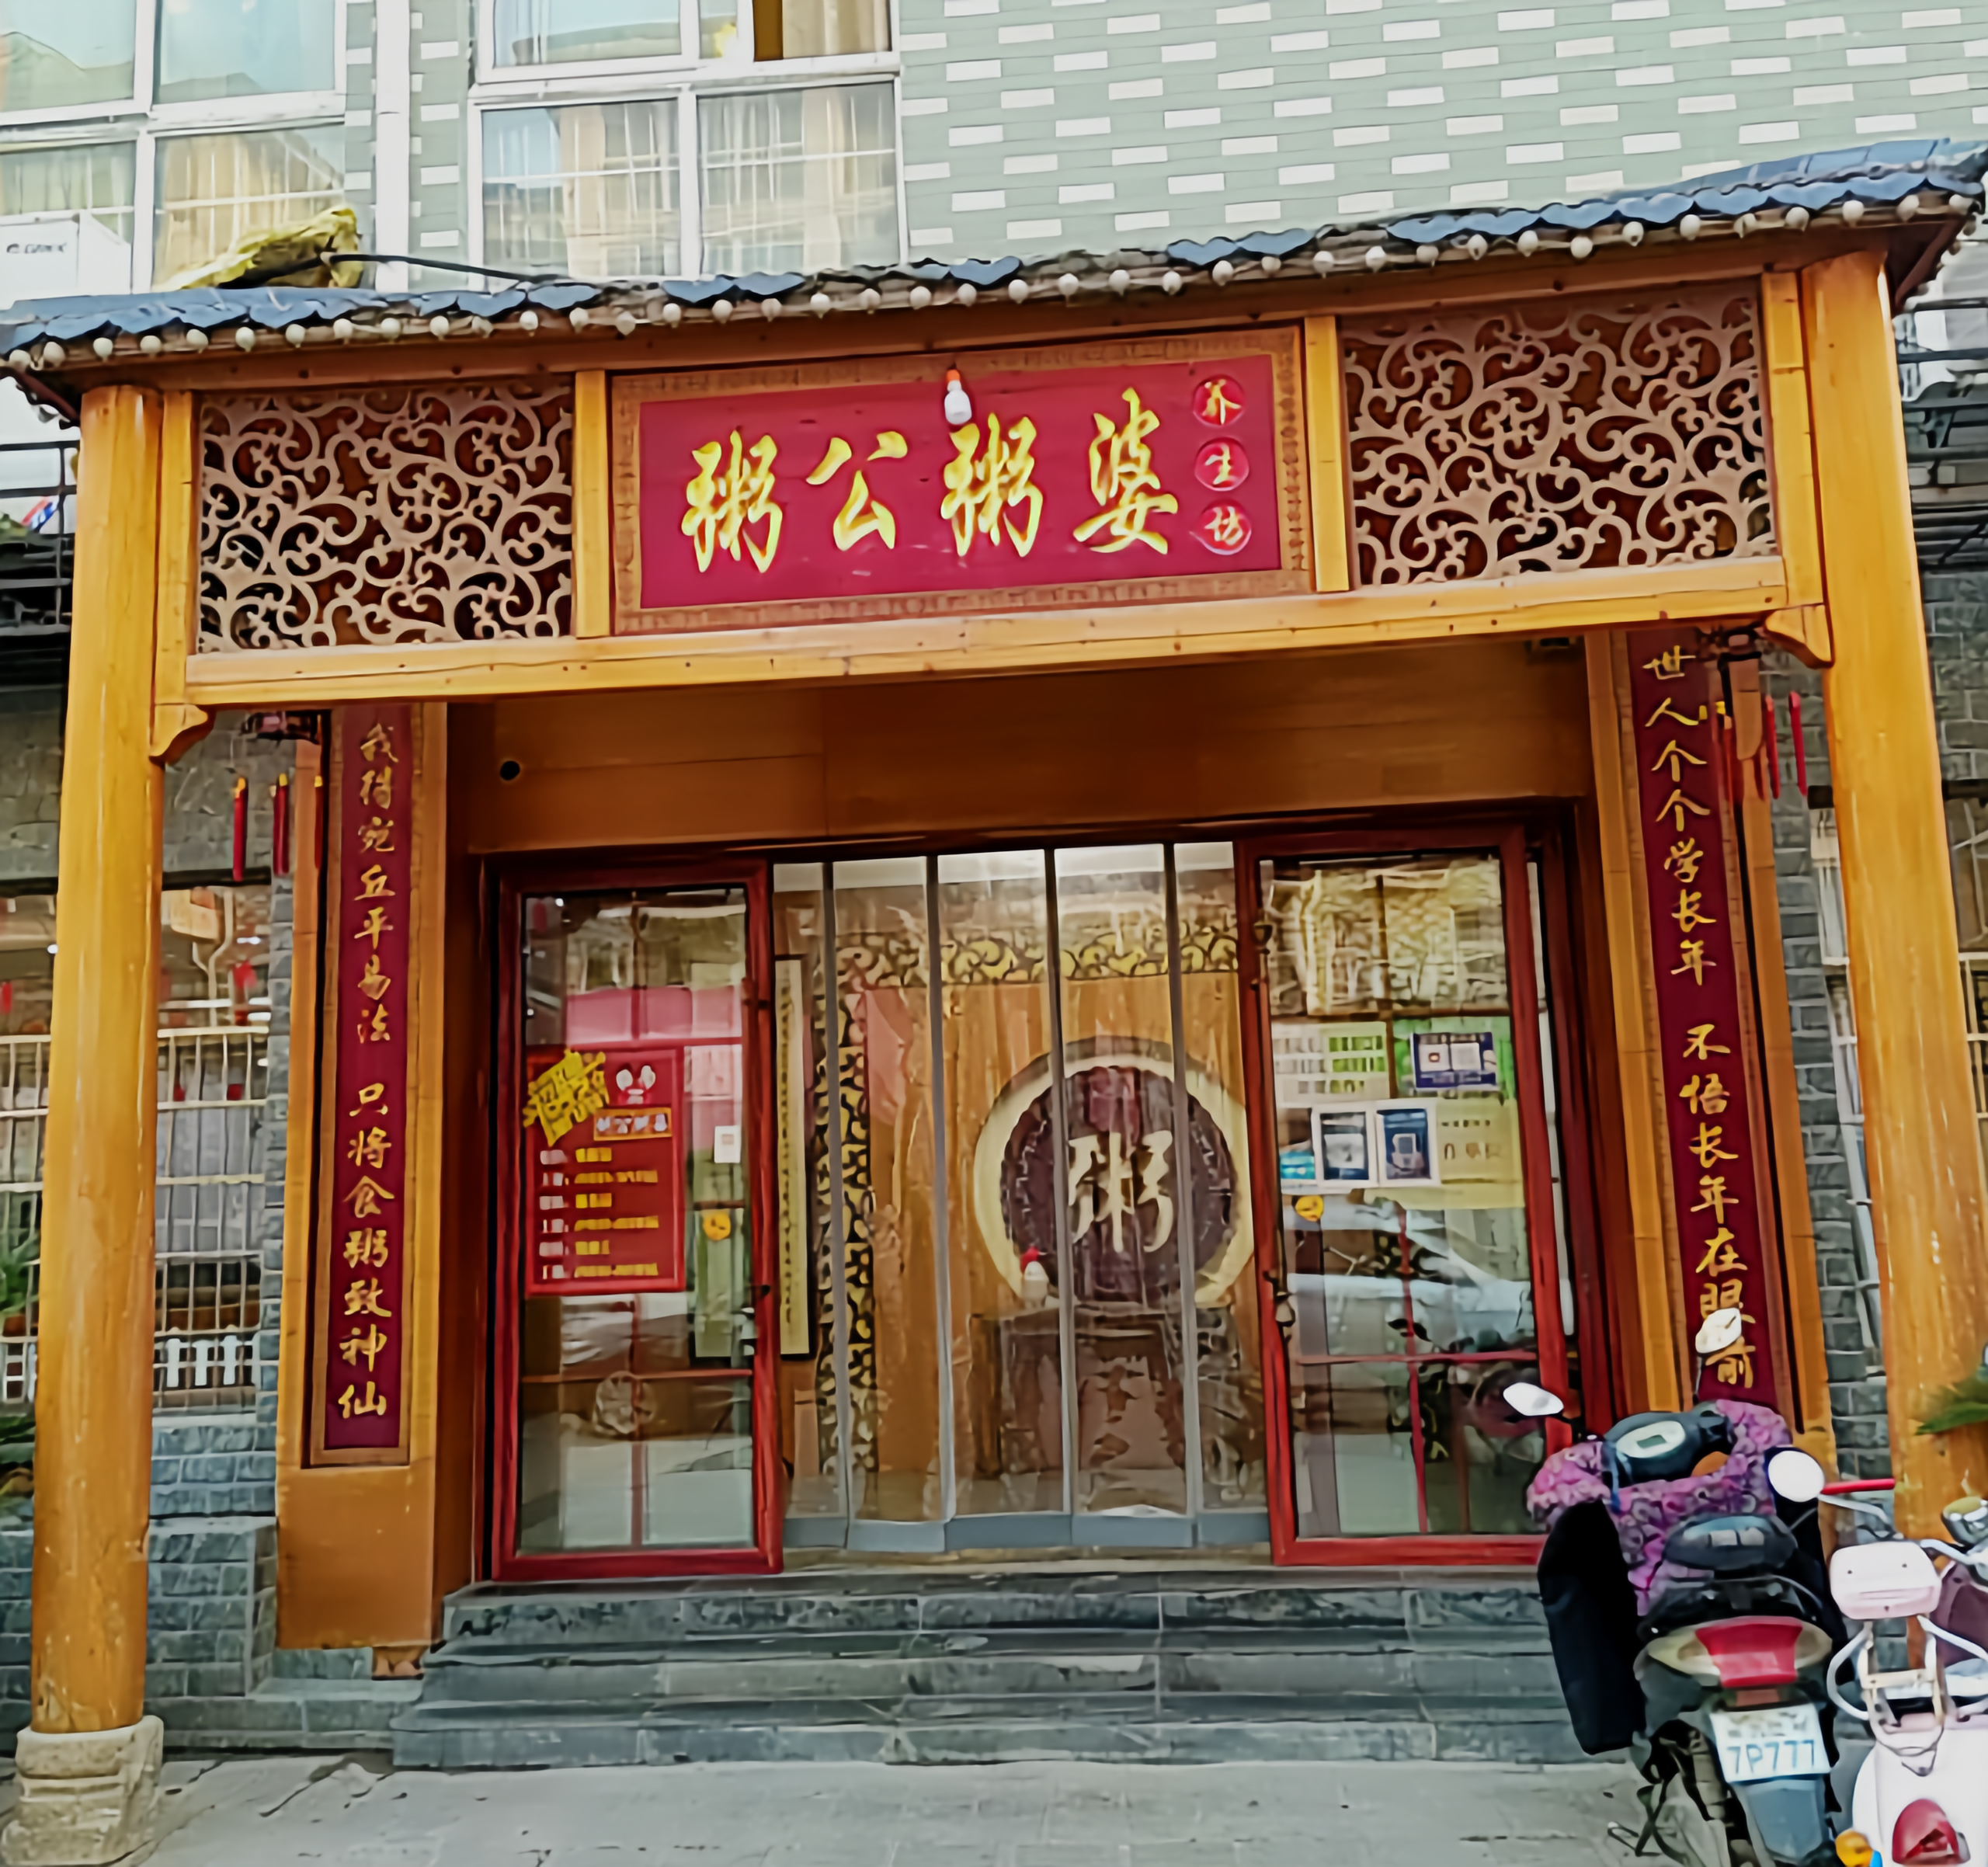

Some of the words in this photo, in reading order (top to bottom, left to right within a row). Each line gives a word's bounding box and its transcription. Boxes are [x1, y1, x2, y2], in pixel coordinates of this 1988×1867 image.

[682, 388, 1179, 572] 粥公粥婆
[1642, 645, 1717, 986] 世人个个学长年
[338, 1083, 394, 1418] 只将食粥致神仙
[1068, 1129, 1173, 1253] 粥
[1726, 1739, 1815, 1775] 7P777
